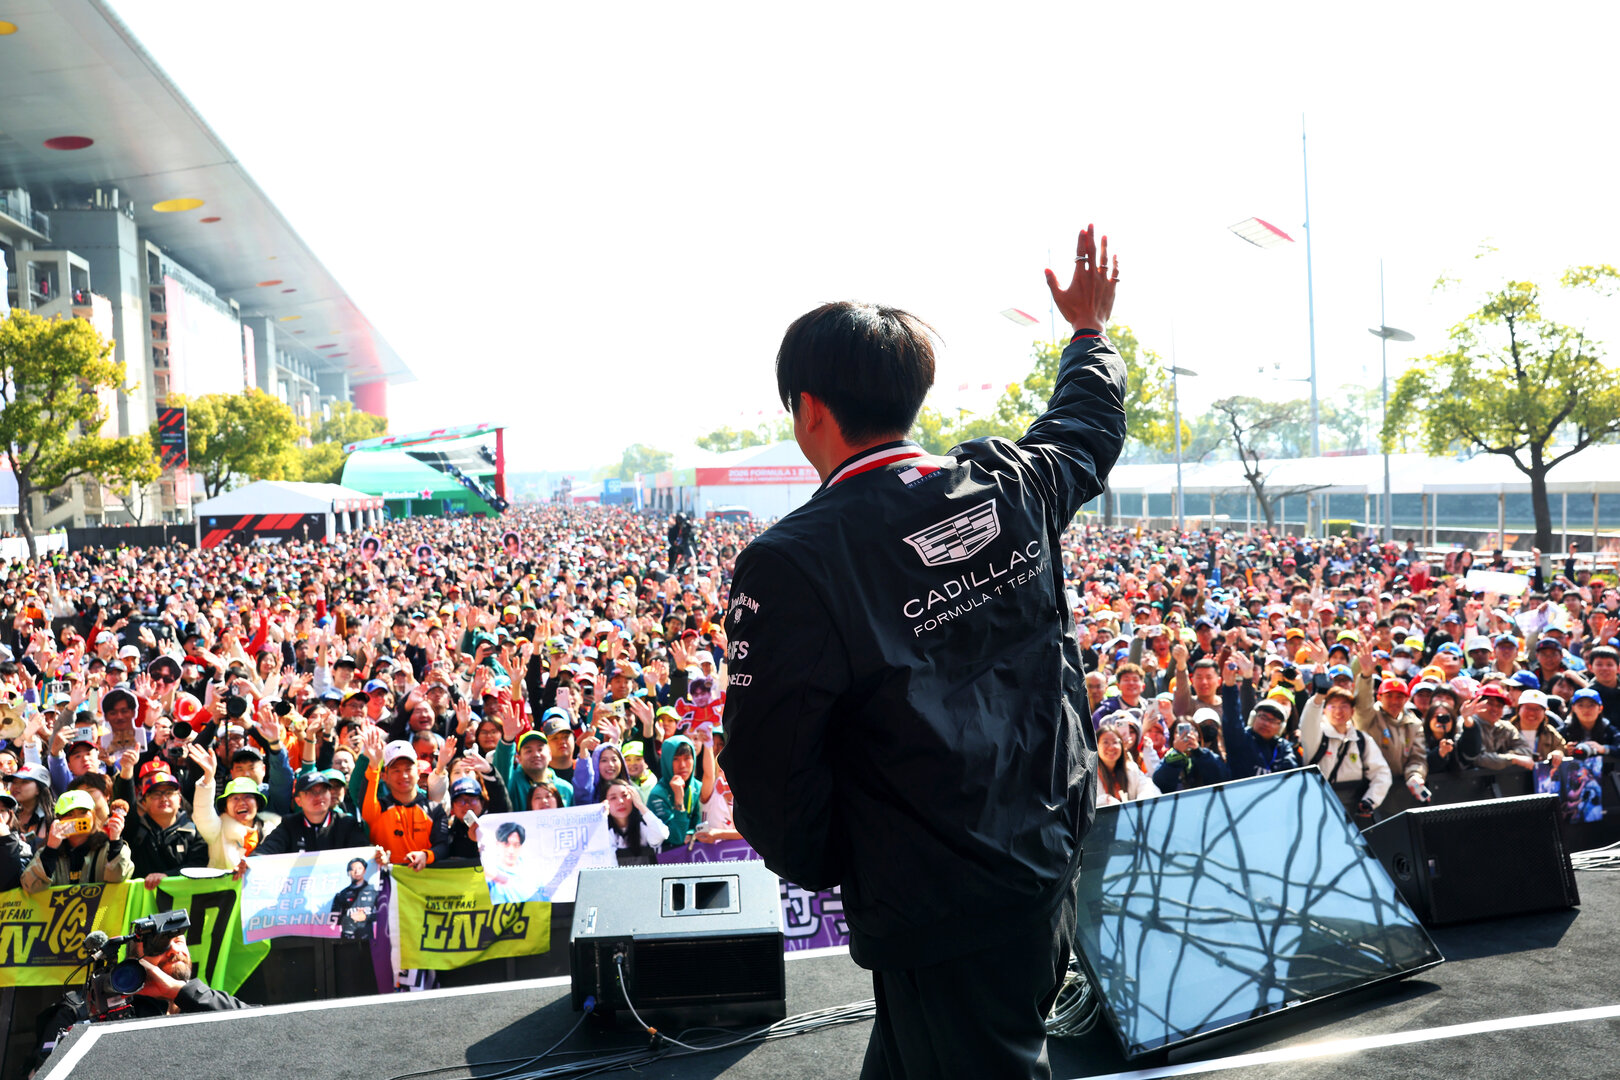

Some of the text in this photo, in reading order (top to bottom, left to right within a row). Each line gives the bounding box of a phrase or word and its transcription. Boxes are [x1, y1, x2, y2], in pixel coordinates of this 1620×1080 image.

[750, 468, 791, 477] FORMULA
[903, 540, 1041, 619] CADILLAC
[913, 592, 993, 638] FORMULA
[1007, 560, 1048, 590] TEAM
[7, 908, 34, 920] FANS
[455, 900, 477, 909] FANS
[248, 912, 342, 932] PUSHING
[422, 911, 487, 950] LN
